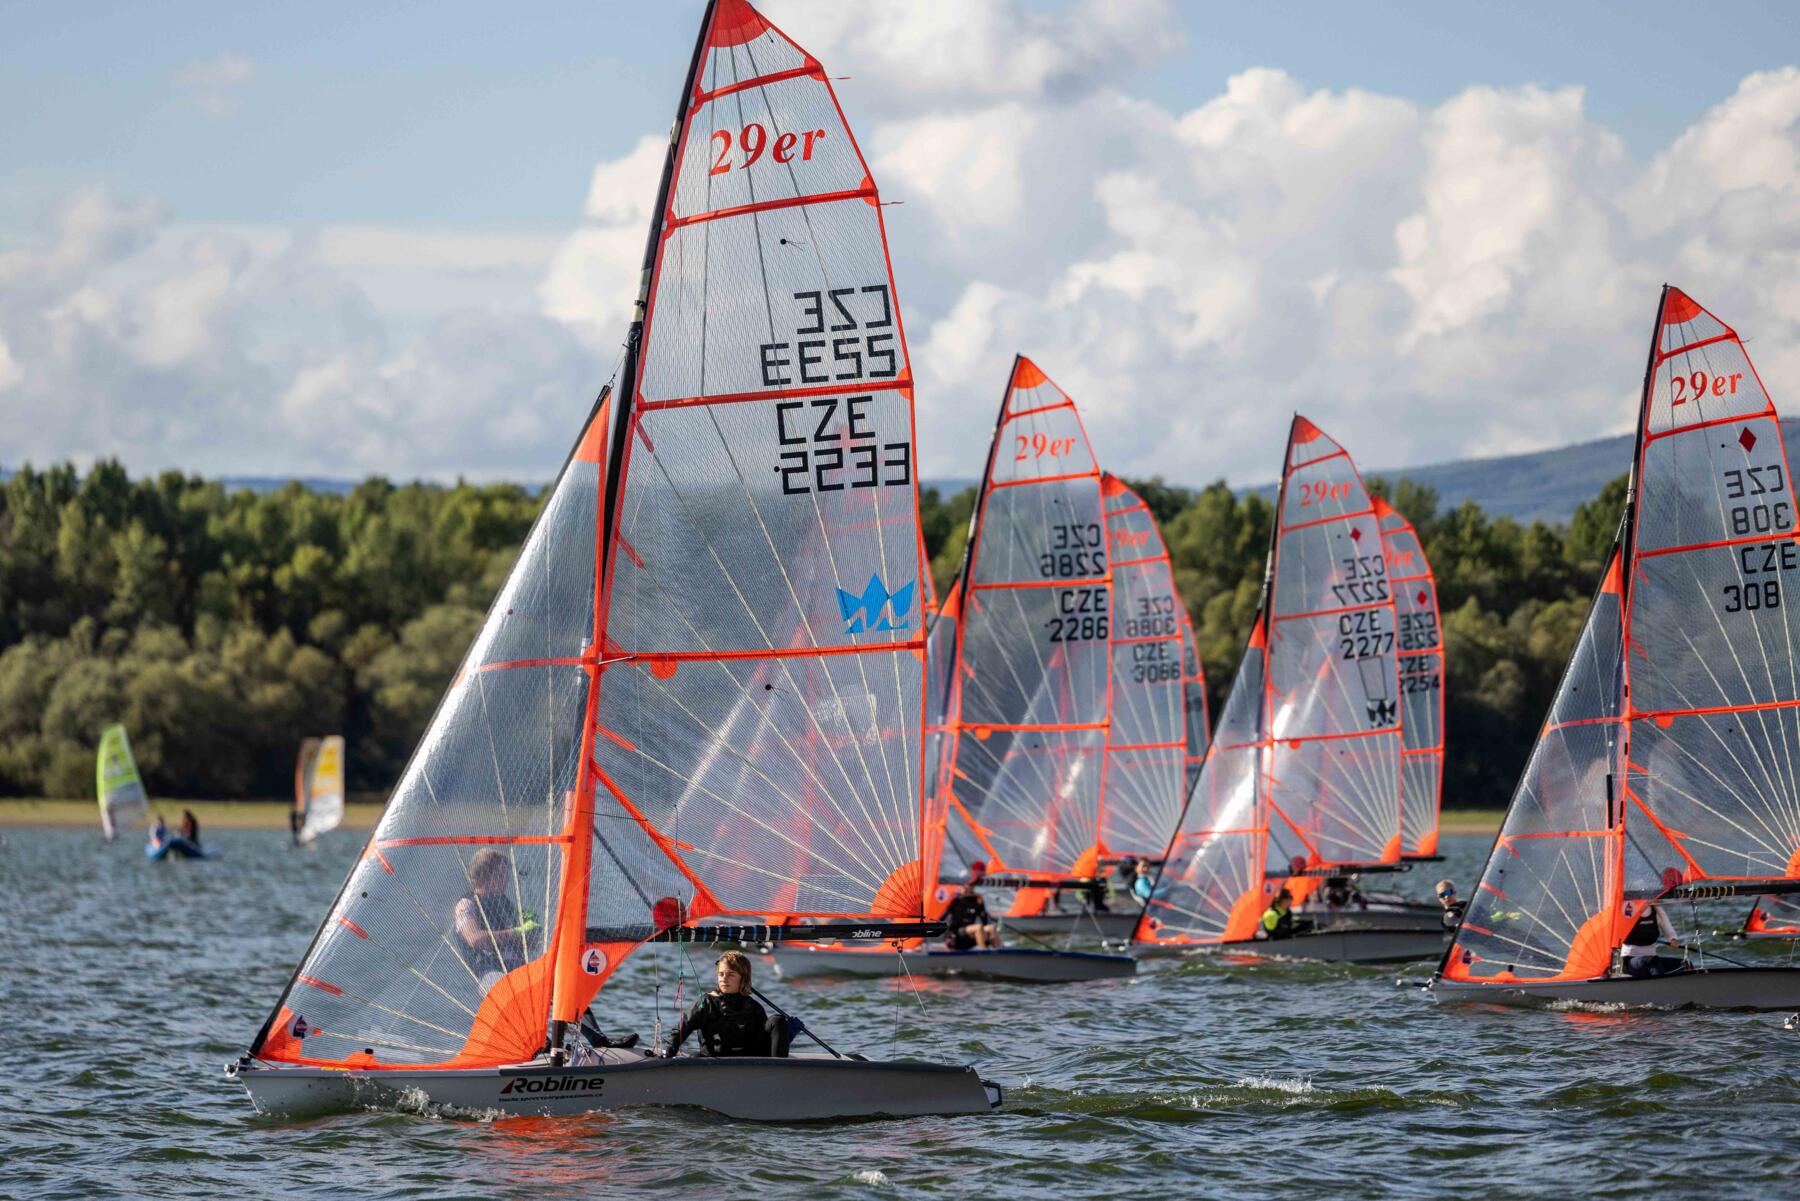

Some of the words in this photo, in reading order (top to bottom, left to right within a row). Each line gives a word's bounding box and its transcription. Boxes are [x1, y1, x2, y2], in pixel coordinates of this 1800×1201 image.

[708, 124, 826, 176] 29er
[1670, 370, 1743, 408] 29er
[776, 396, 876, 445] CZE
[1014, 432, 1077, 461] 29er
[780, 442, 910, 495] 2233
[1300, 479, 1353, 507] 29er
[1741, 542, 1797, 575] CZE
[1061, 589, 1107, 615] CZE
[1723, 580, 1781, 613] 308
[1050, 617, 1109, 643] 2286
[1340, 610, 1382, 636] CZE
[1132, 641, 1170, 662] CZE
[1342, 632, 1395, 661] 2277
[500, 1075, 605, 1094] Robline
